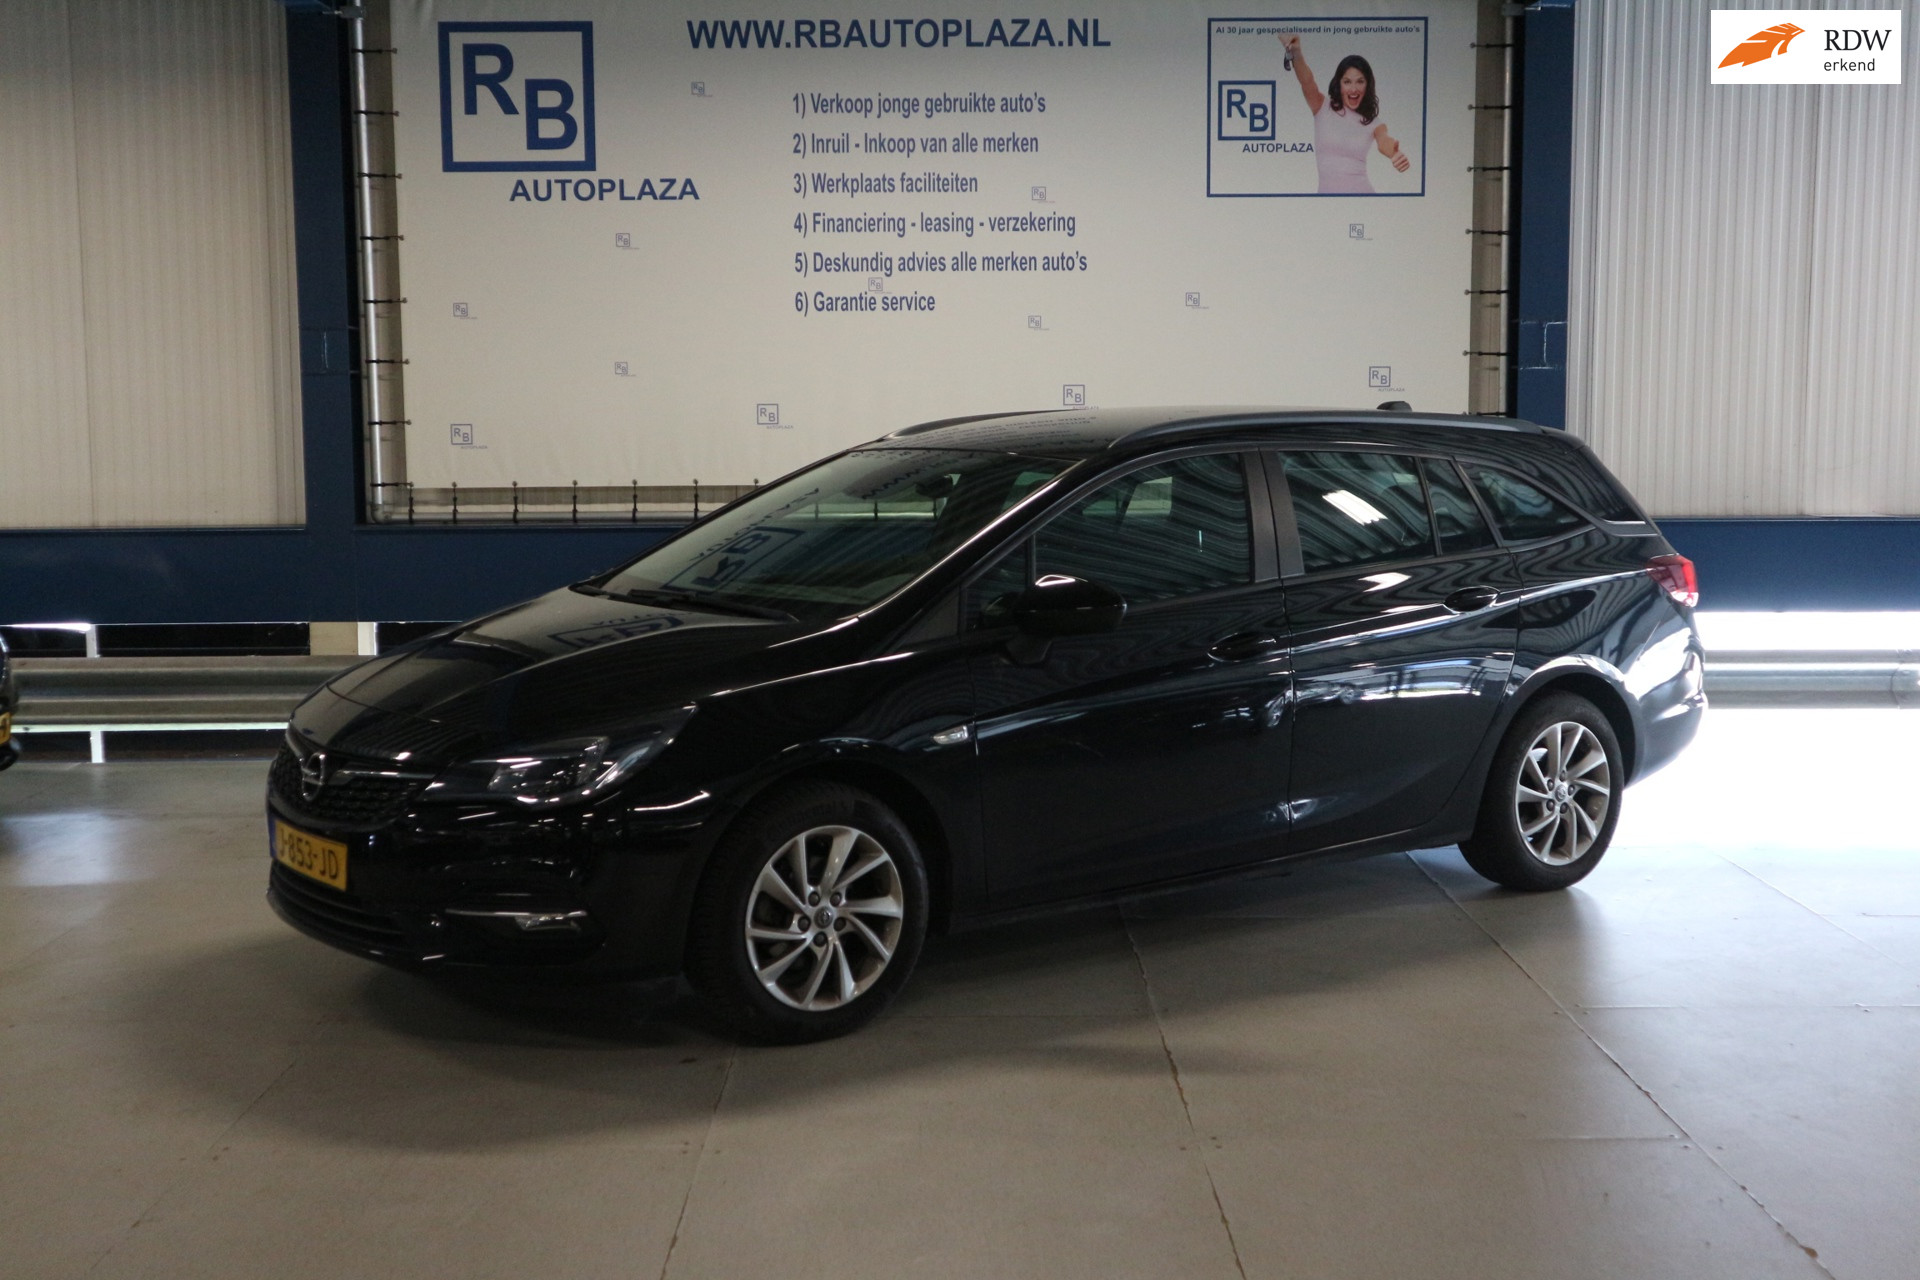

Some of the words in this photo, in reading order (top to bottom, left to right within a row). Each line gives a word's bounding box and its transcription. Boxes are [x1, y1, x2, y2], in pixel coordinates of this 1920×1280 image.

[687, 18, 1111, 49] WWW.RBAUTOPLAZA.NL
[1227, 26, 1237, 34] 30
[1238, 26, 1254, 35] jaar
[1256, 25, 1321, 35] gespecialiseerd
[1323, 25, 1331, 33] in
[1333, 25, 1352, 35] jong
[1354, 25, 1393, 34] gebruikte
[1395, 25, 1420, 33] auto's
[462, 43, 578, 150] RB
[793, 92, 806, 119] 1)
[811, 92, 873, 119] Verkoop
[877, 92, 920, 119] jonge
[925, 91, 996, 118] gebruikte
[1000, 91, 1046, 113] auto's
[1226, 89, 1270, 132] RB
[793, 132, 806, 159] 2)
[811, 132, 849, 153] Inruil
[864, 132, 916, 158] Inkoop
[920, 137, 948, 153] van
[952, 131, 978, 153] alle
[983, 131, 1039, 153] merken
[1242, 143, 1314, 153] AUTOPLAZA
[509, 178, 700, 202] AUTOPLAZA
[793, 172, 807, 199] 3)
[811, 172, 896, 198] Werkplaats
[900, 171, 978, 193] faciliteiten
[793, 212, 807, 239] 4)
[813, 211, 906, 238] Financiering
[920, 211, 974, 238] leasing
[988, 211, 1076, 237] verzekering
[795, 251, 808, 278] 5)
[813, 251, 893, 277] Deskundig
[898, 251, 946, 272] advies
[951, 251, 977, 272] alle
[981, 251, 1037, 272] merken
[1042, 250, 1088, 272] auto's
[795, 291, 808, 317] 6)
[813, 291, 877, 312] Garantie
[881, 291, 936, 312] service
[280, 828, 339, 880] J-853-JD
